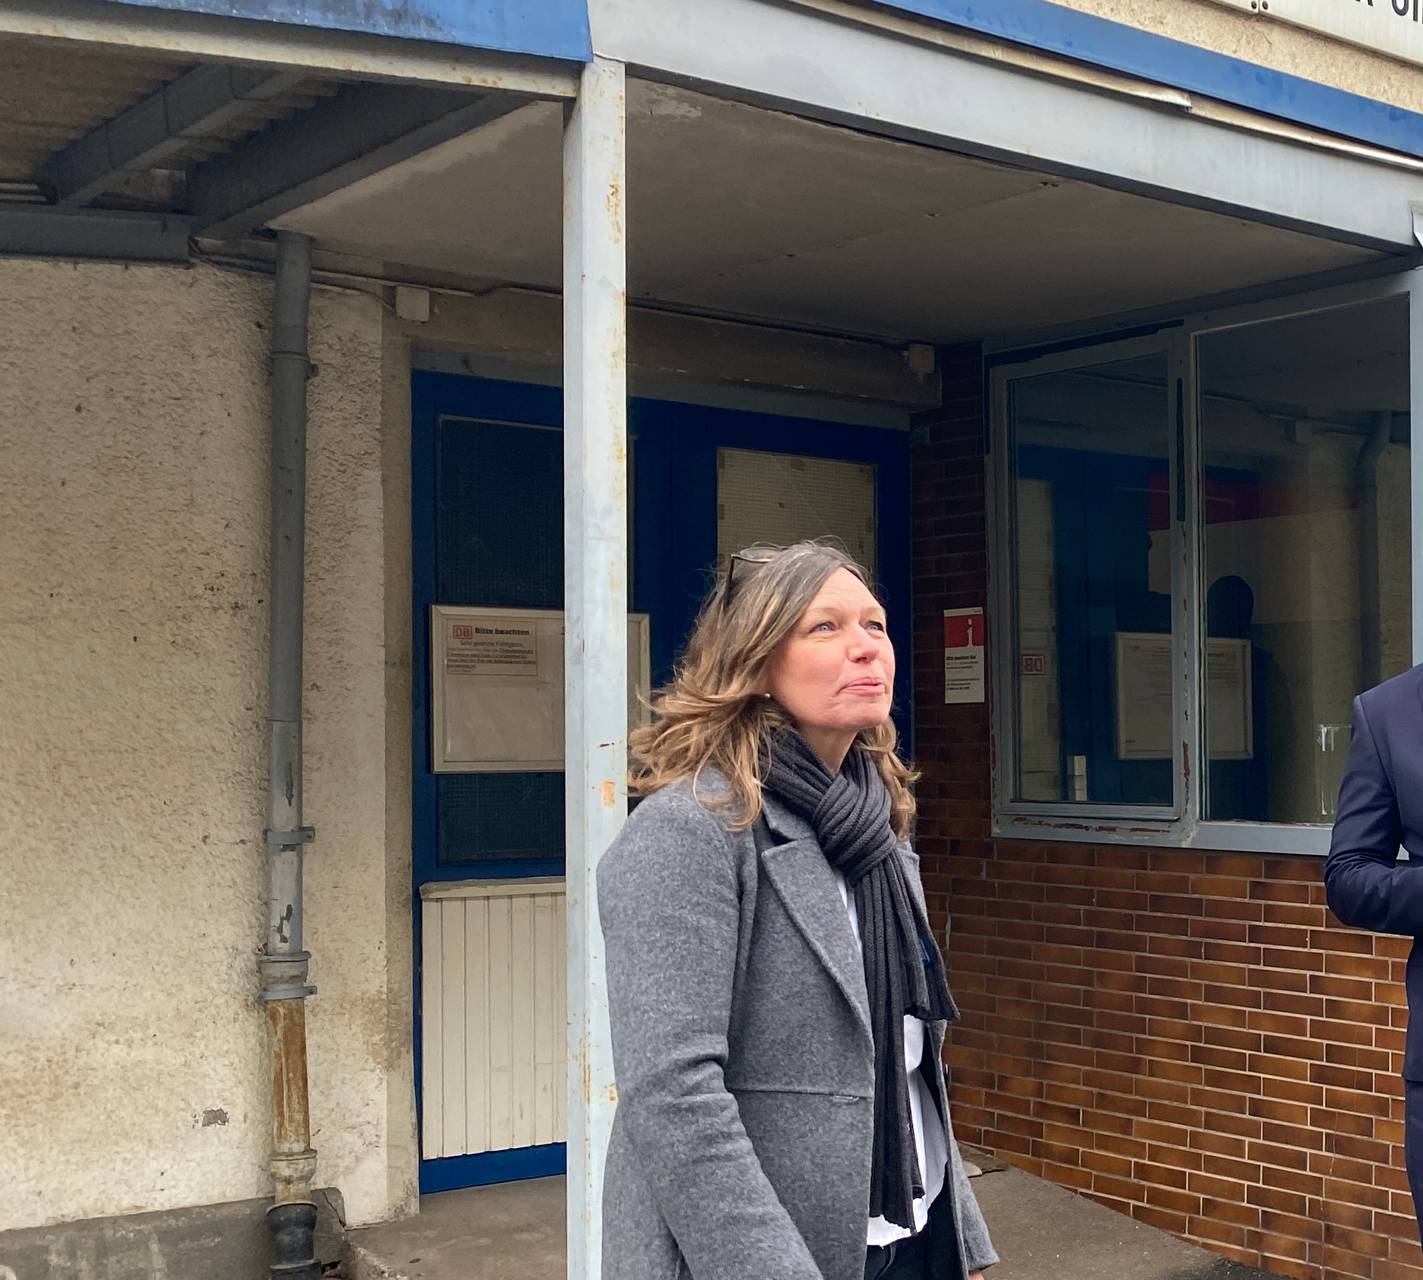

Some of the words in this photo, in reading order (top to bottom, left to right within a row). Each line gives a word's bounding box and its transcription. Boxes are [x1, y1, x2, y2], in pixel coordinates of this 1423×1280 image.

[454, 626, 471, 638] DB
[475, 626, 493, 634] Bitte
[494, 627, 530, 636] beachten
